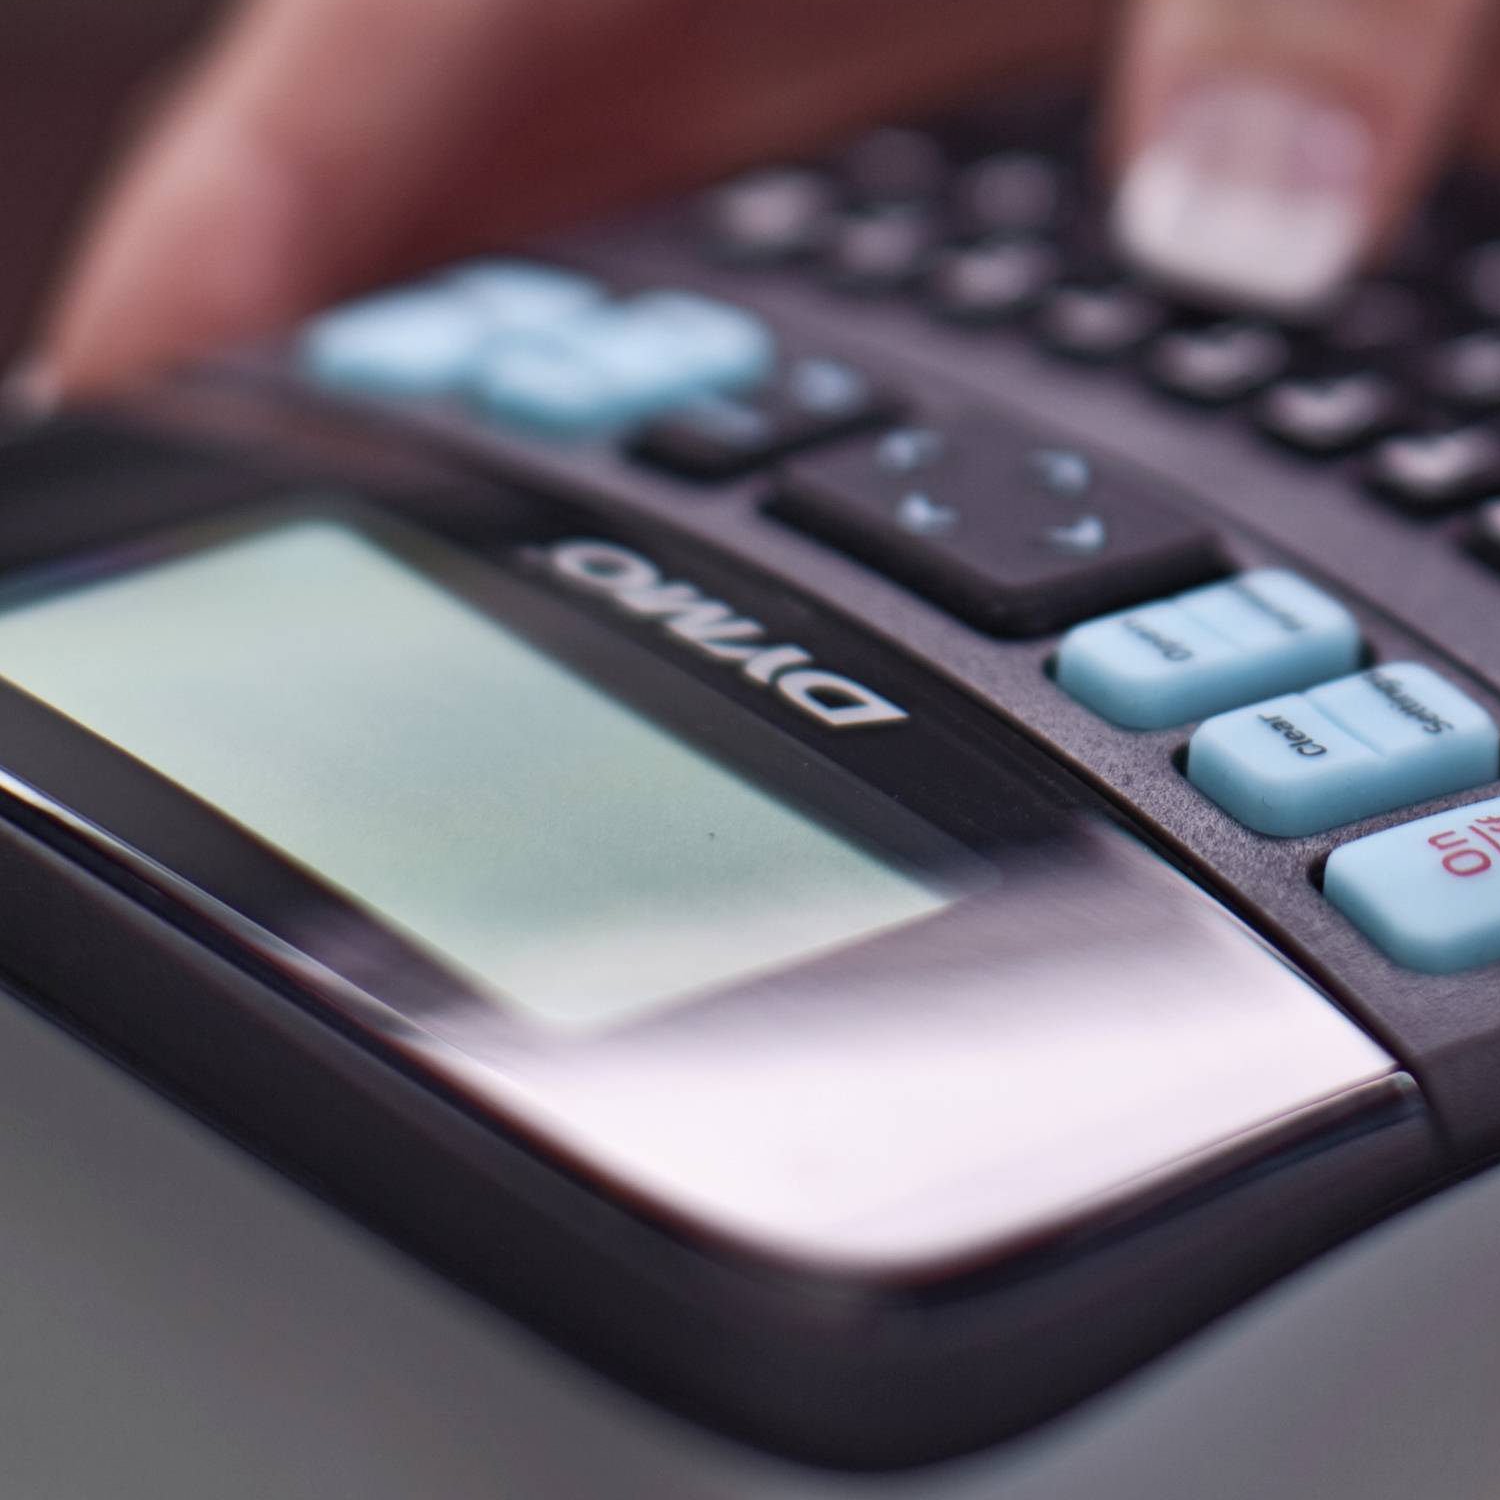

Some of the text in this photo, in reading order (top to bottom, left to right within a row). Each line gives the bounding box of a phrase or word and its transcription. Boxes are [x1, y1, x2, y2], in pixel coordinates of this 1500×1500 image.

[552, 538, 909, 726] DYMO
[1258, 713, 1328, 757] Clear
[1427, 828, 1492, 877] On
